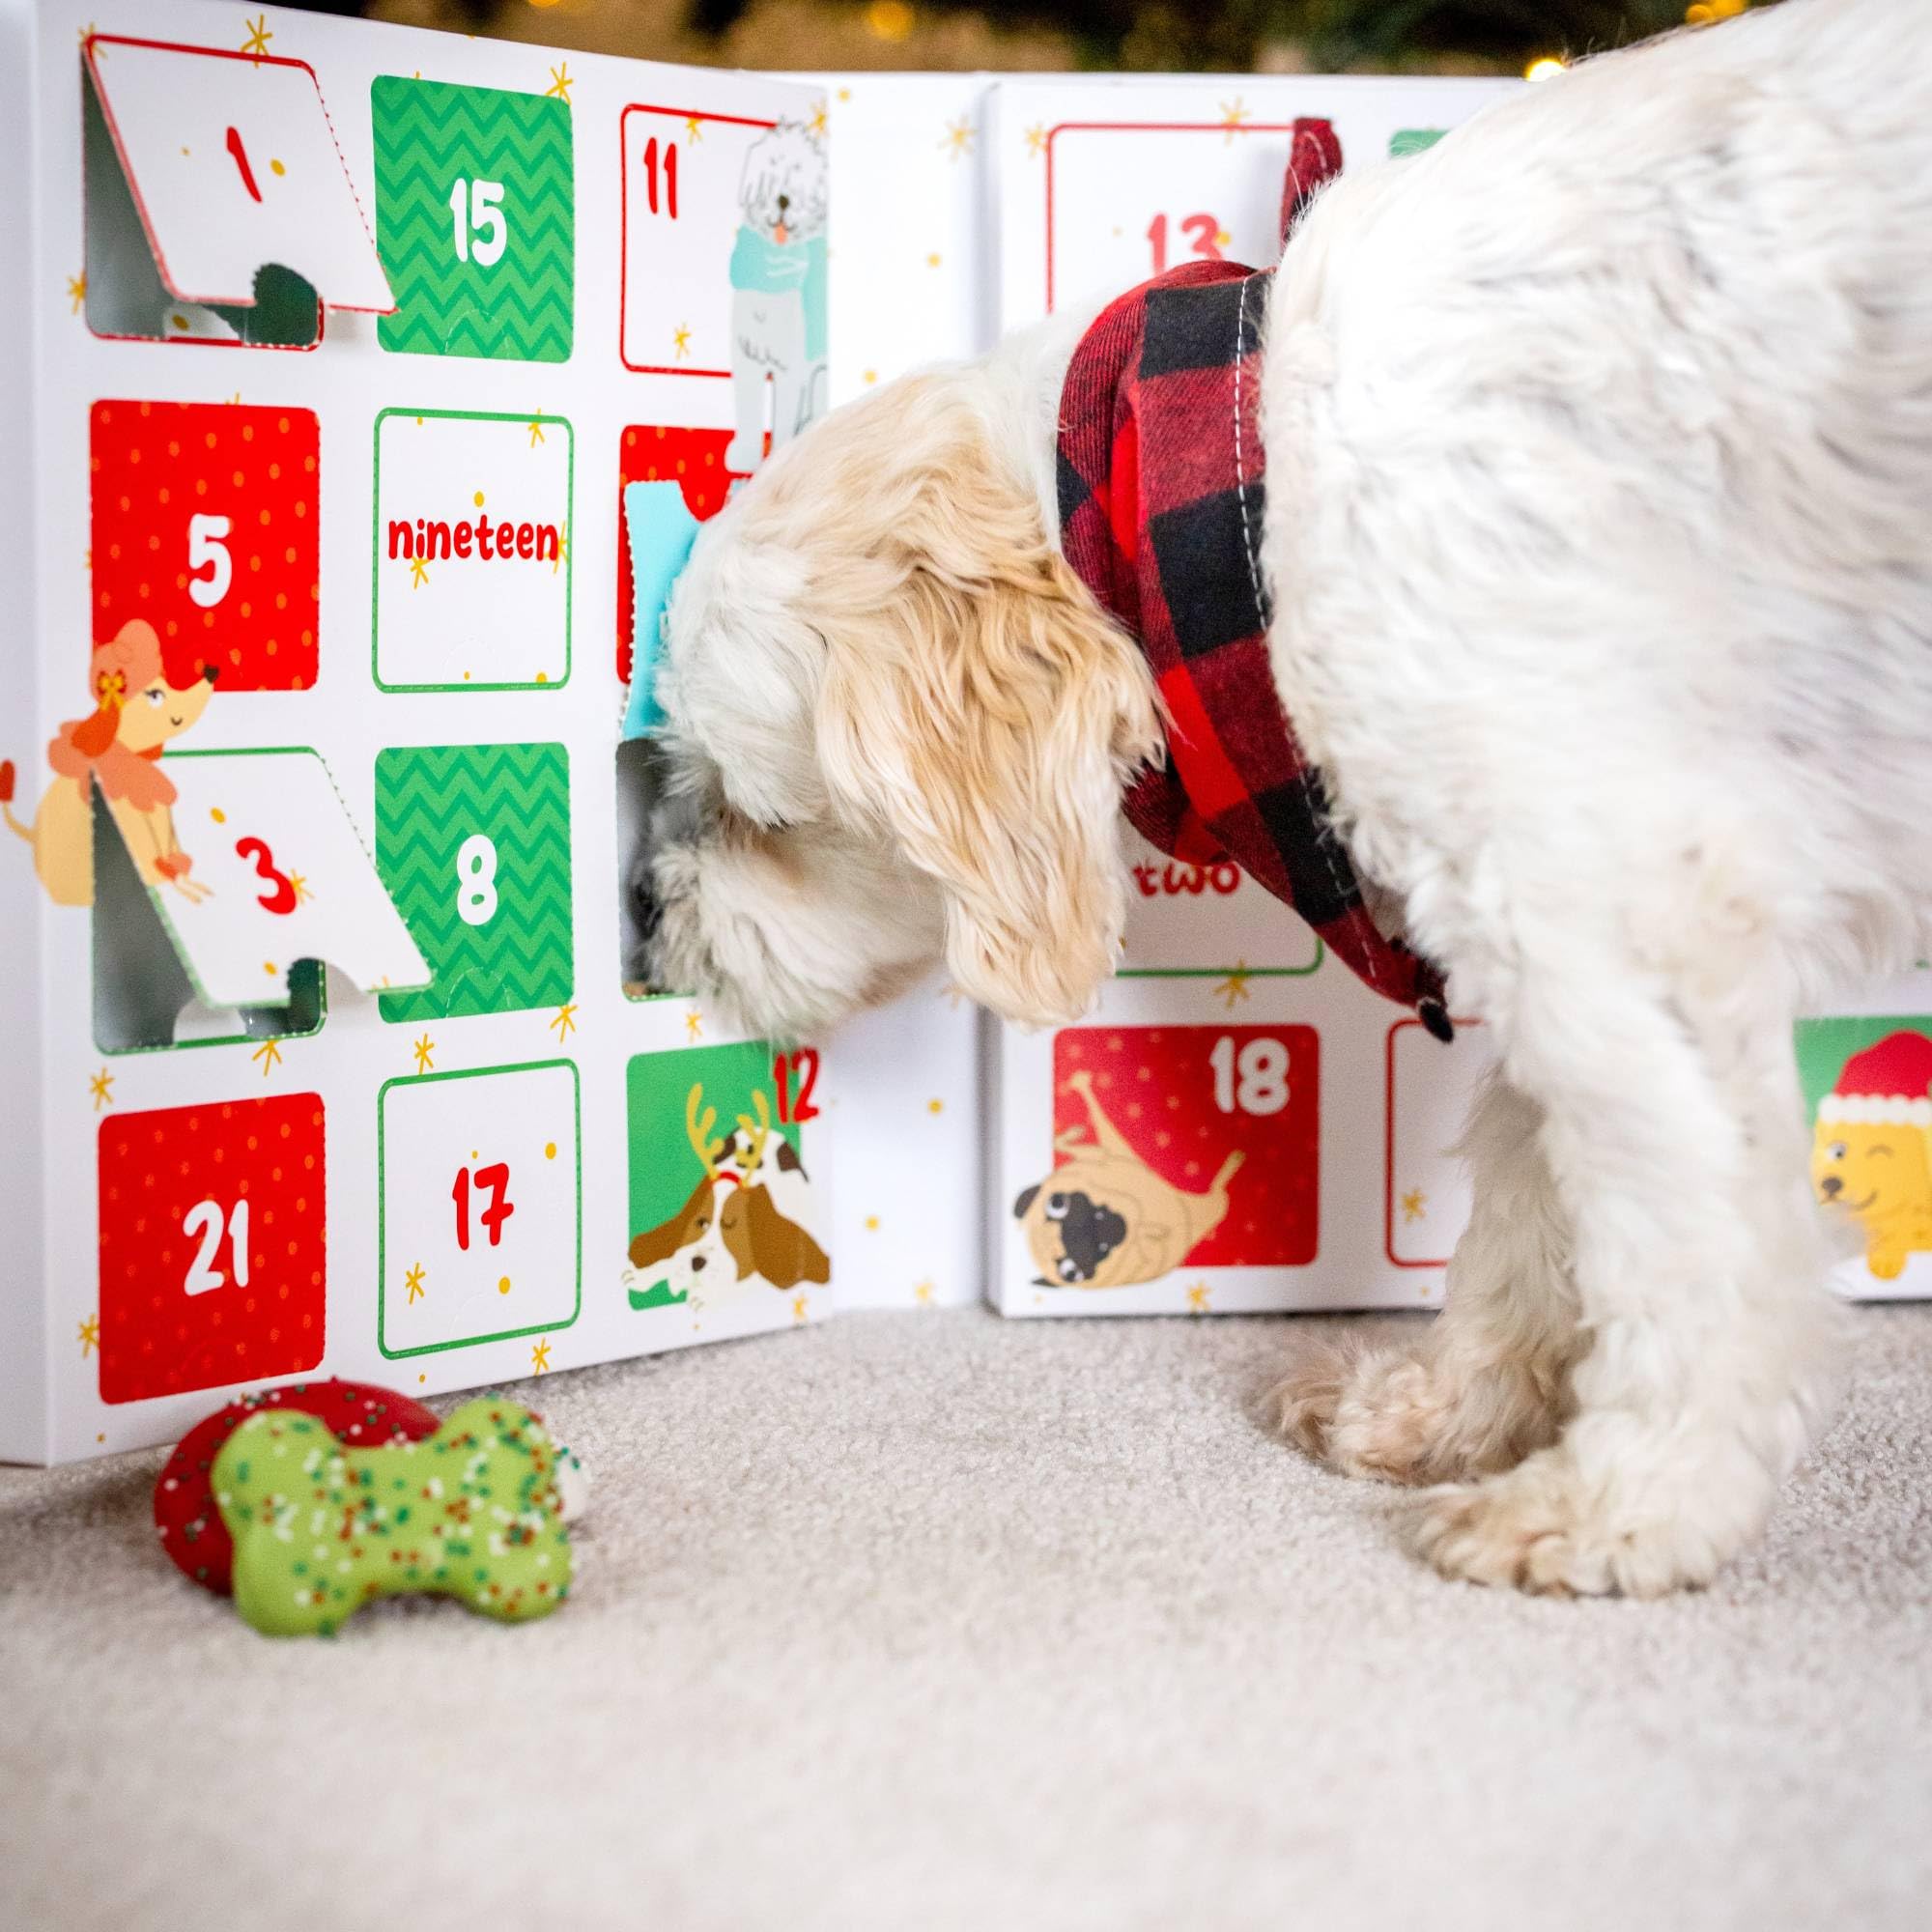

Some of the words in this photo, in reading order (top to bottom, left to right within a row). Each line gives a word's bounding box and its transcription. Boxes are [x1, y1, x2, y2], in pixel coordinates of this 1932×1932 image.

[225, 126, 263, 203] 1
[643, 137, 679, 220] 11
[448, 178, 508, 268] 15
[1146, 213, 1223, 276] 13
[188, 514, 232, 608] 5
[387, 514, 558, 562] nineteen
[235, 836, 298, 916] 3
[455, 833, 498, 926] 8
[1133, 859, 1242, 897] two
[774, 1046, 820, 1124] 12
[1208, 1037, 1290, 1116] 18
[451, 1161, 516, 1251] 17
[183, 1200, 250, 1296] 21
